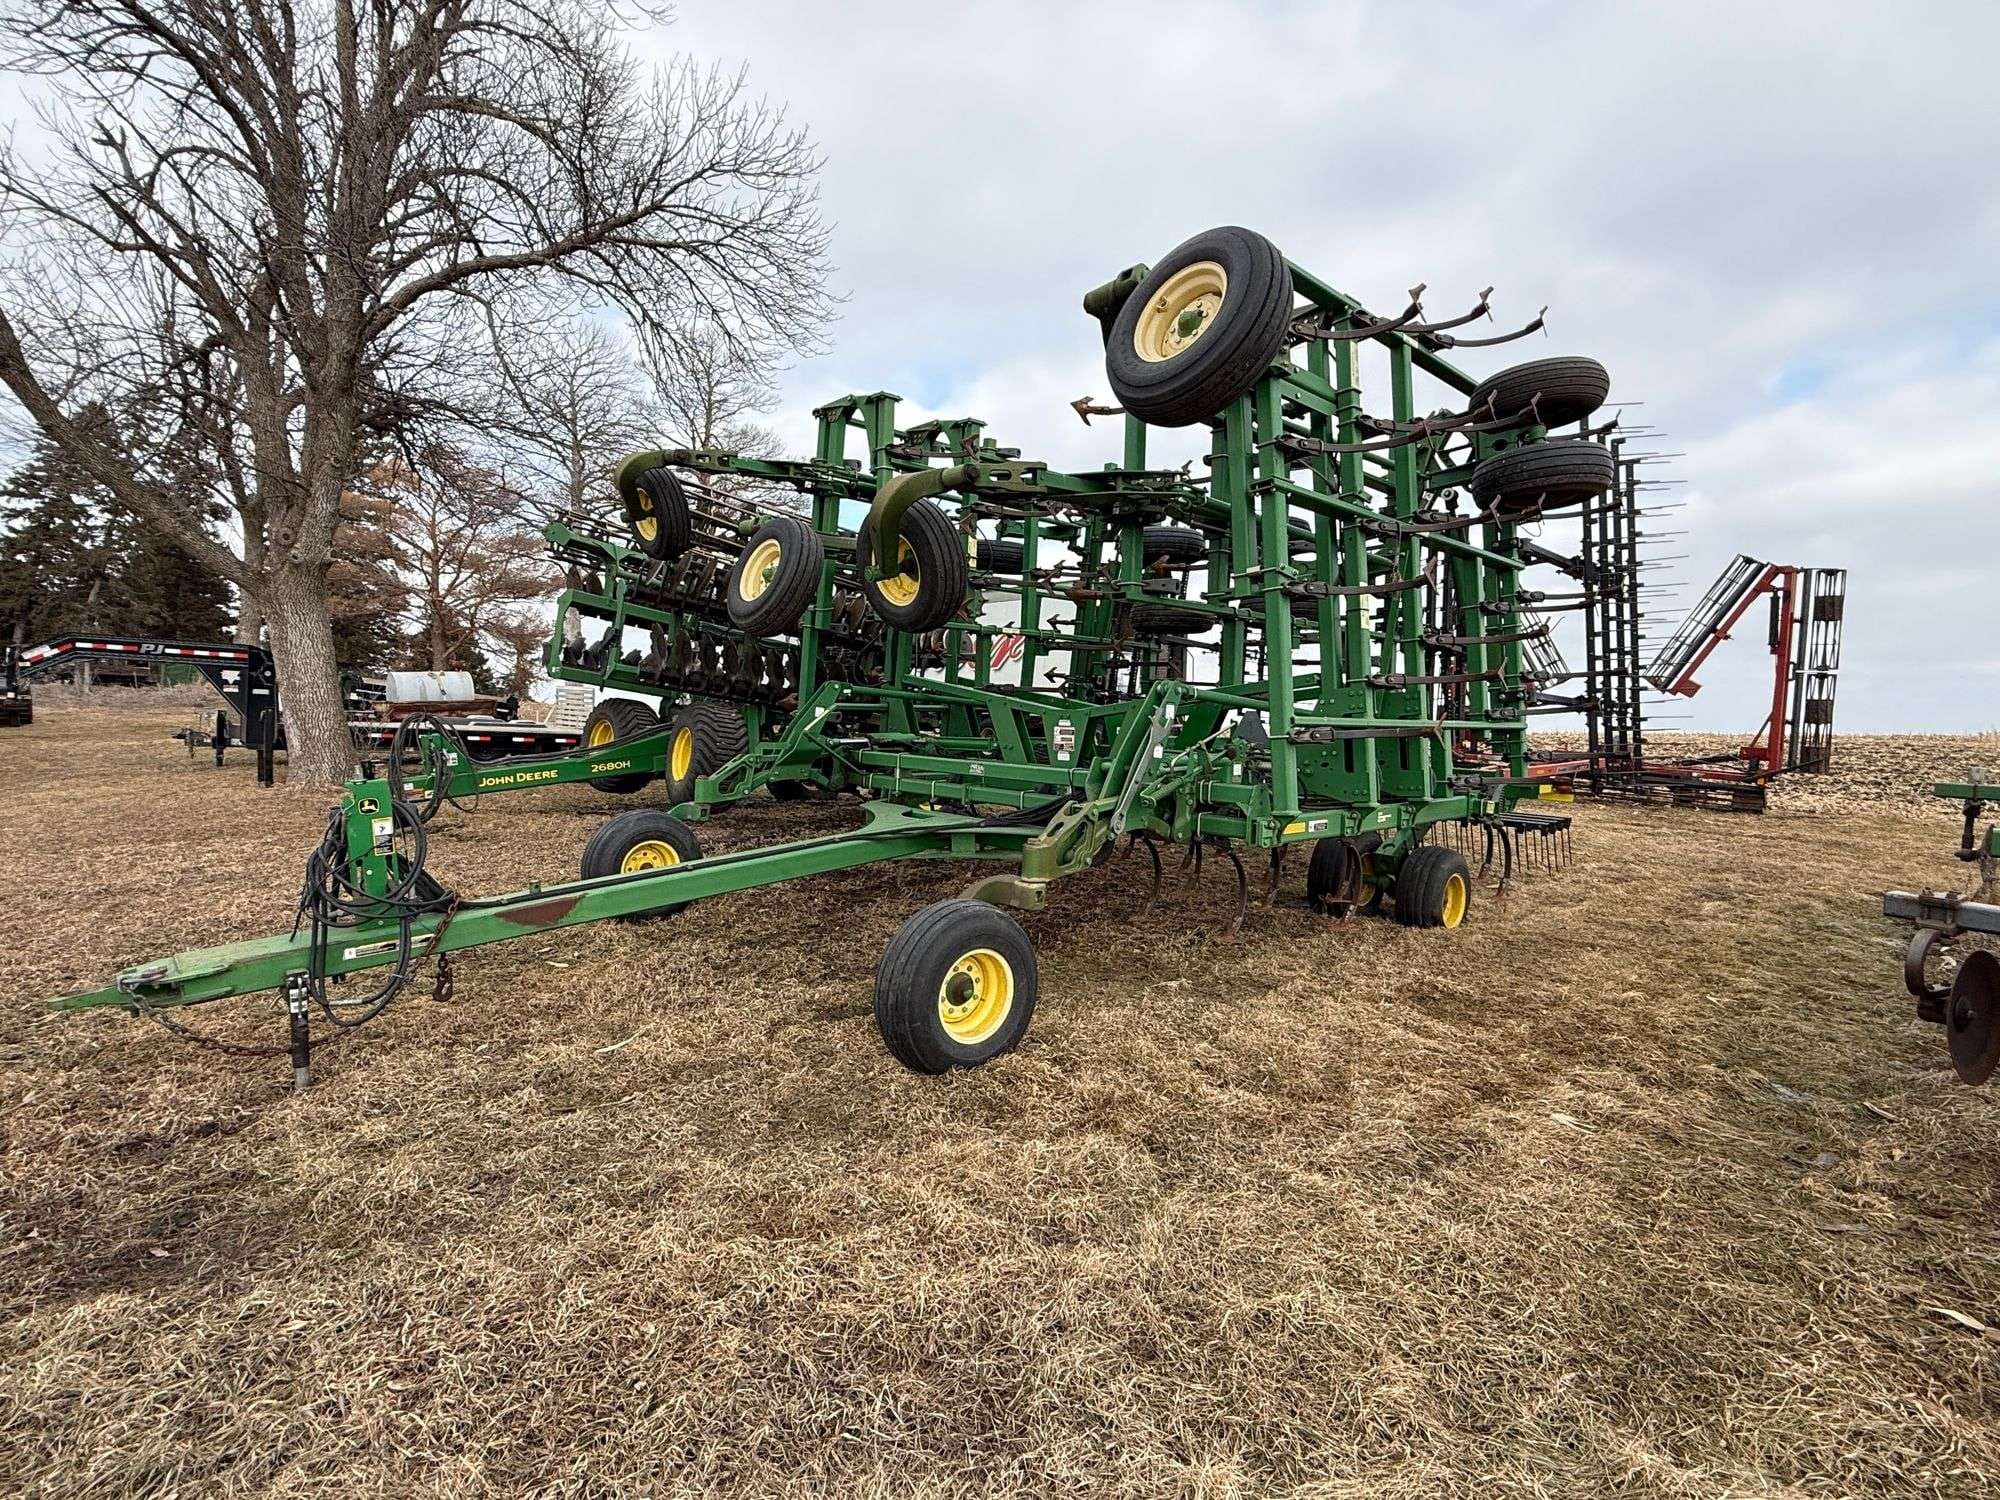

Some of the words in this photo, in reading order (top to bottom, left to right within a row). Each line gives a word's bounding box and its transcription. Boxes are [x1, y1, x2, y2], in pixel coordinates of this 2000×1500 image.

[139, 643, 165, 655] PJ
[591, 760, 631, 773] 2680H
[479, 775, 514, 788] JOHN
[516, 769, 559, 782] DEERE
